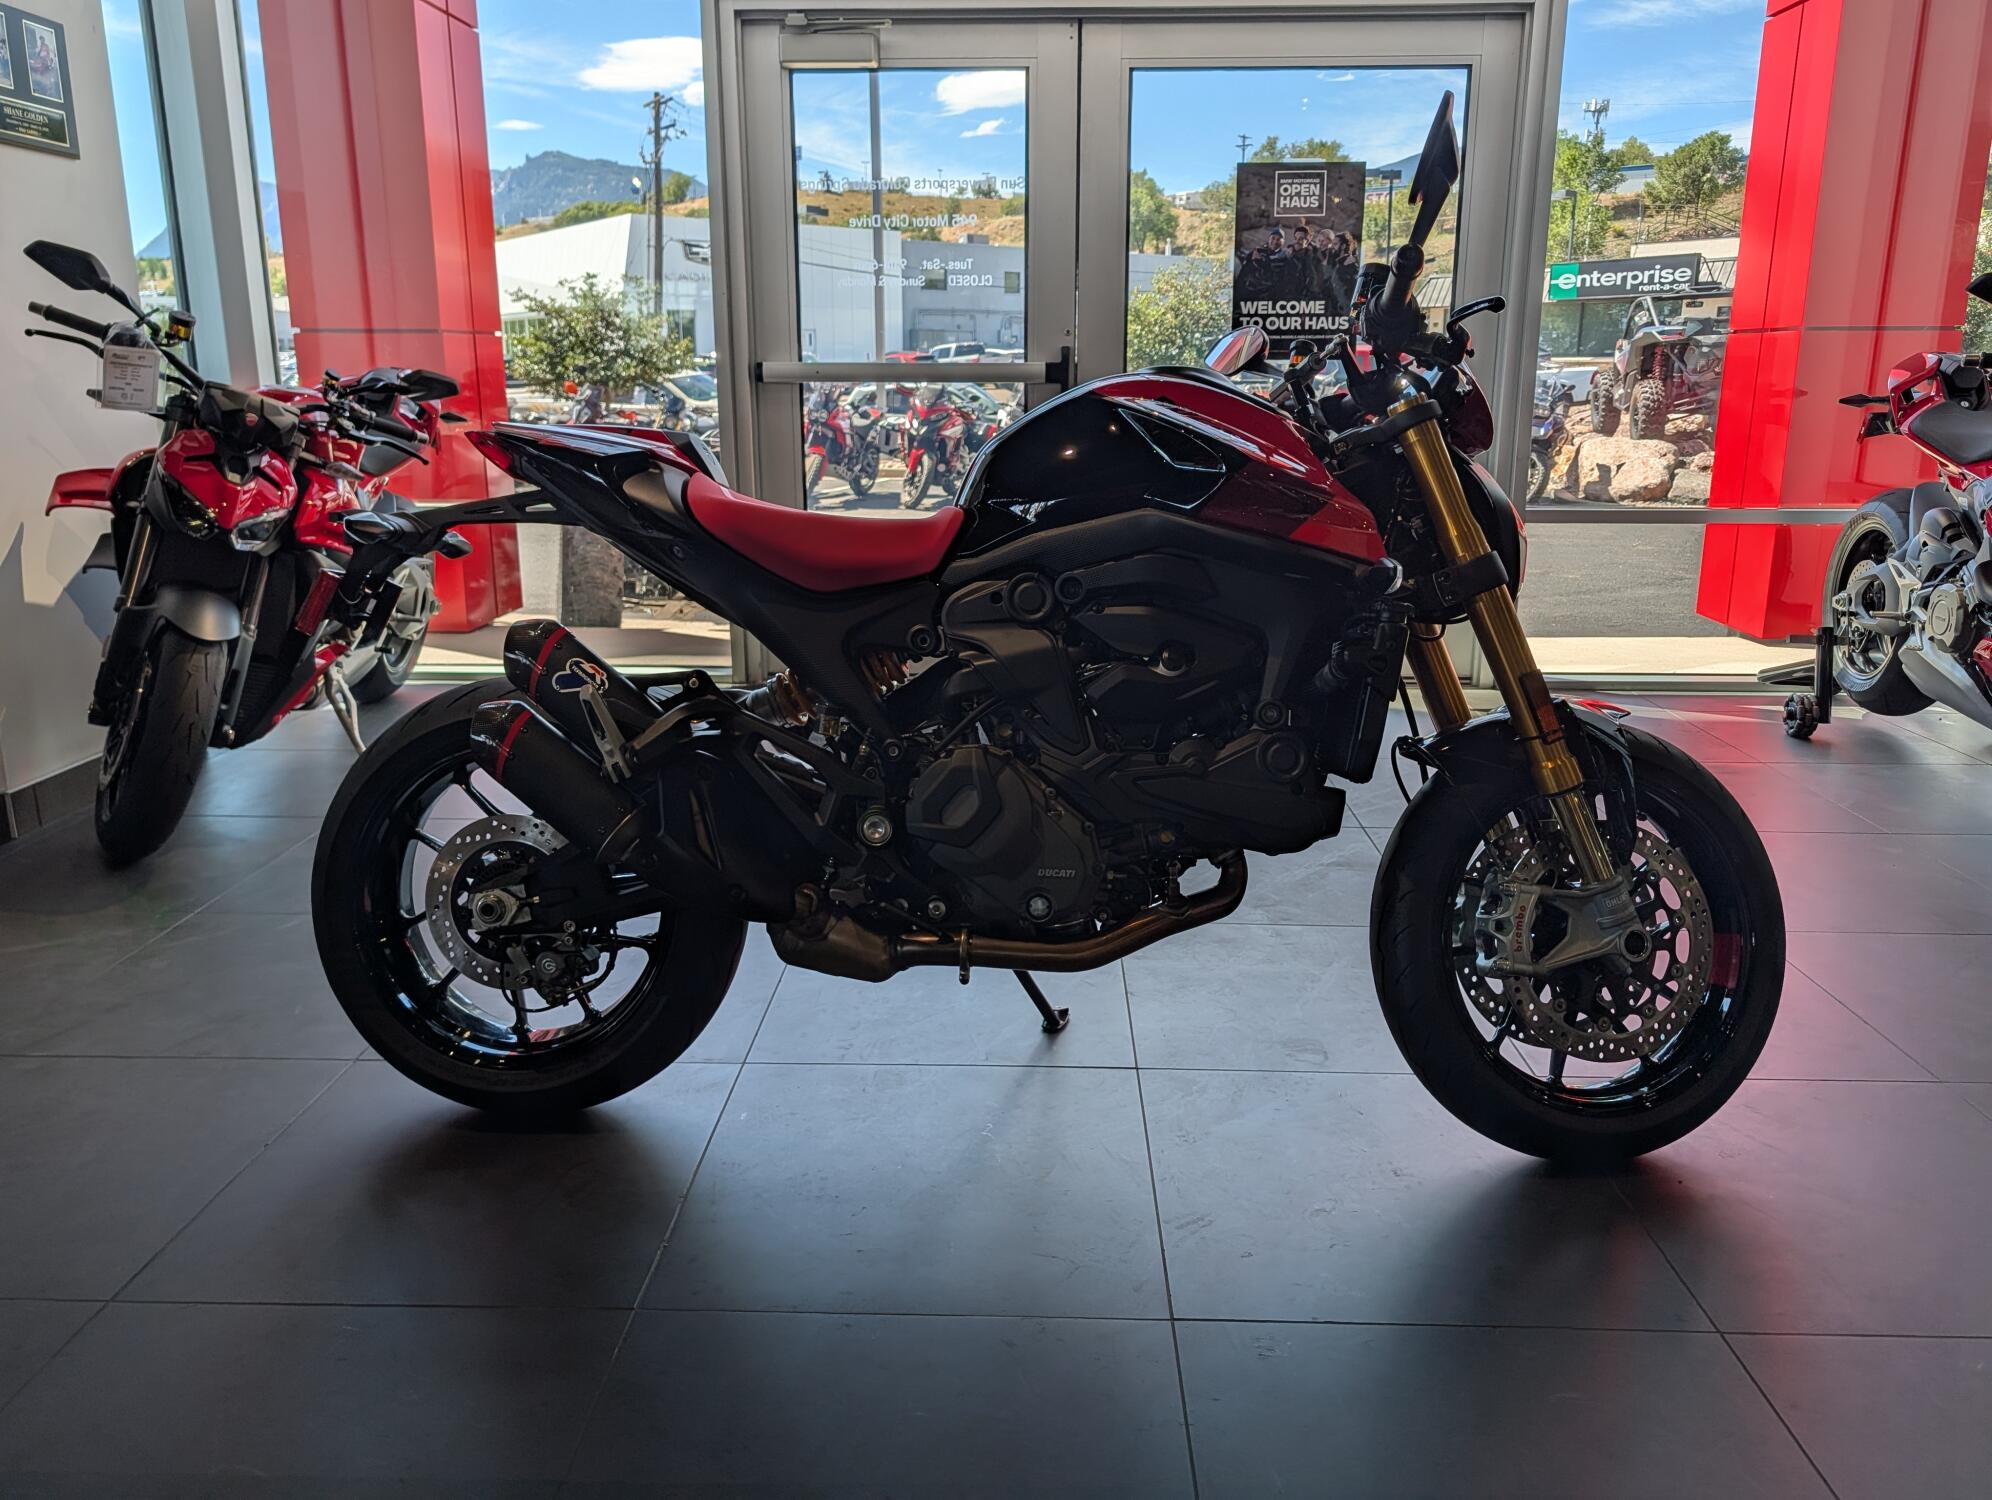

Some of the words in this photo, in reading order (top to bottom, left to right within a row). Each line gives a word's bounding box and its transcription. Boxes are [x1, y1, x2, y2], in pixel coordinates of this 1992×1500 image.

[1279, 184, 1320, 196] OPEN
[1279, 196, 1320, 208] HAUS
[1551, 264, 1692, 290] enterprise
[1239, 300, 1326, 315] WELCOME
[1239, 316, 1264, 328] TO
[1265, 316, 1302, 331] OUR
[1304, 316, 1350, 330] HAUS
[1037, 868, 1077, 878] DUCATI
[1513, 904, 1527, 953] brembo
